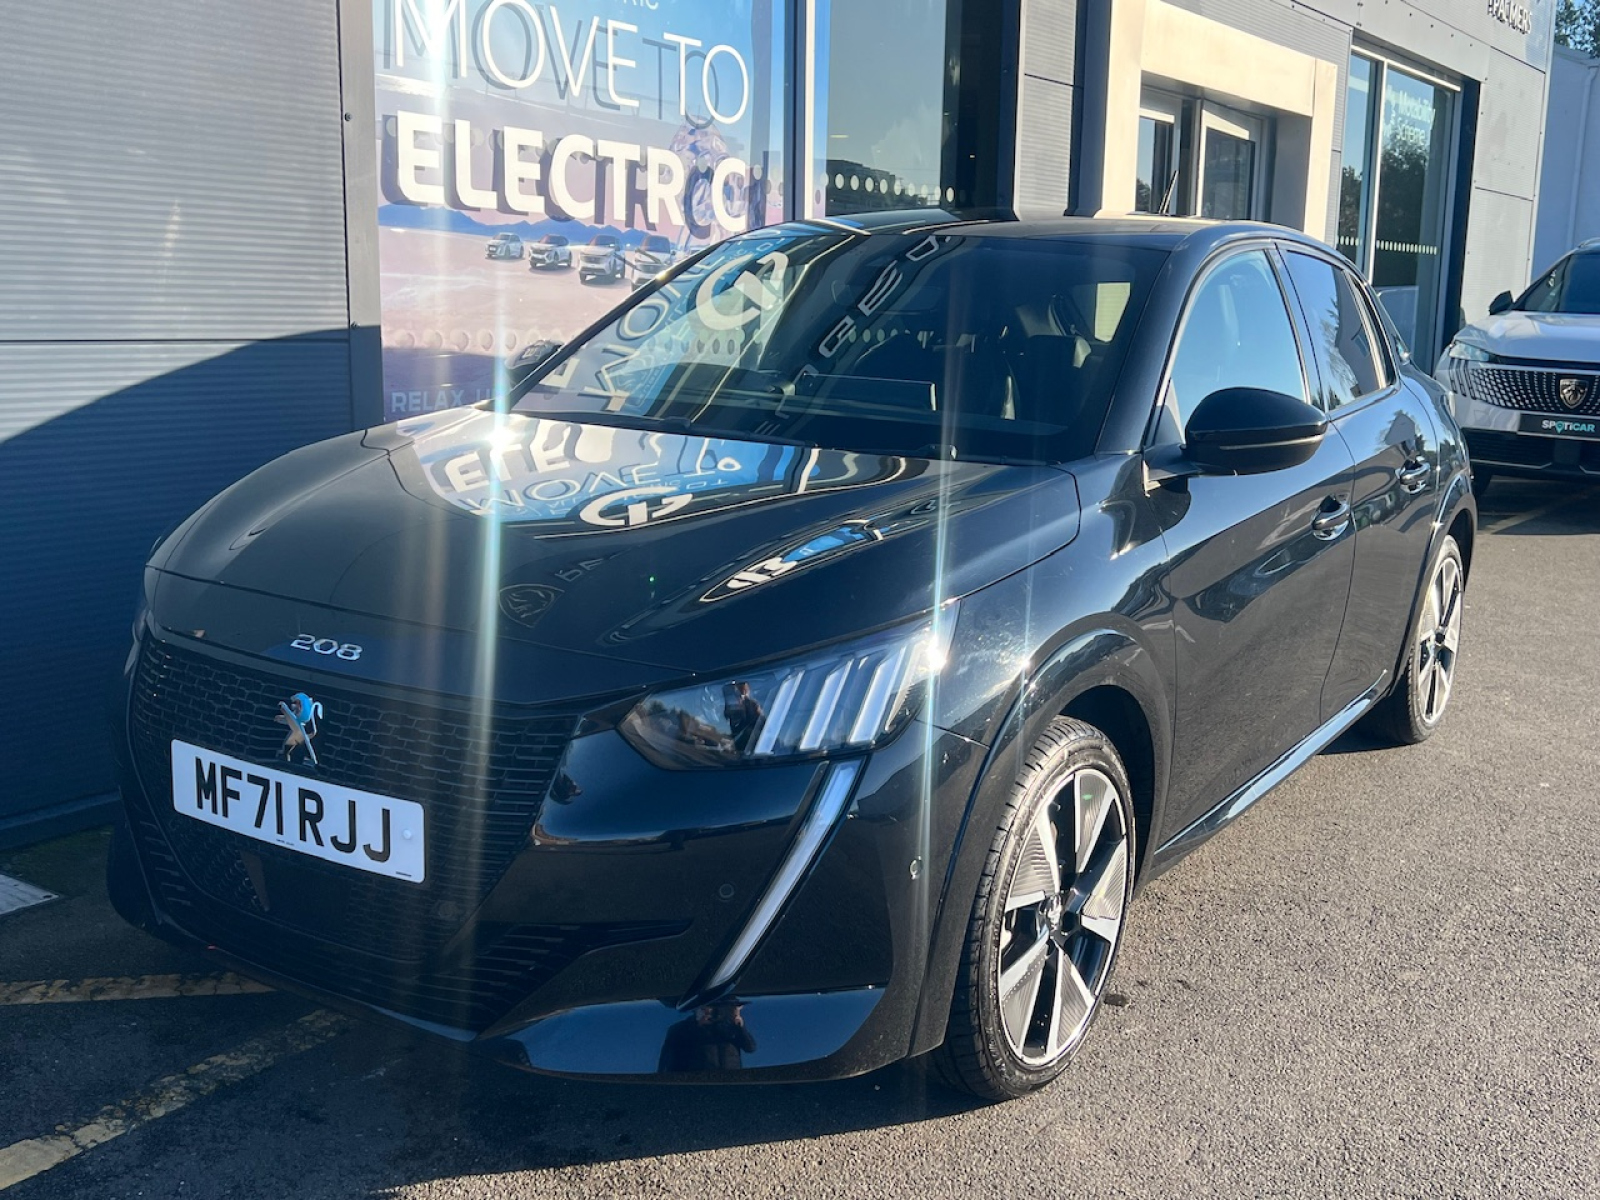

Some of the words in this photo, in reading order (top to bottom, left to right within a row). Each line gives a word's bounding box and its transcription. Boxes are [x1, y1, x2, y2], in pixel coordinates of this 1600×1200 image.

[394, 0, 639, 108] MOVE
[663, 32, 750, 125] TO
[396, 110, 748, 232] ELECTRC
[391, 390, 465, 413] RELAX
[290, 634, 363, 661] 208
[195, 756, 285, 836] MF71
[298, 787, 391, 863] RJJ
